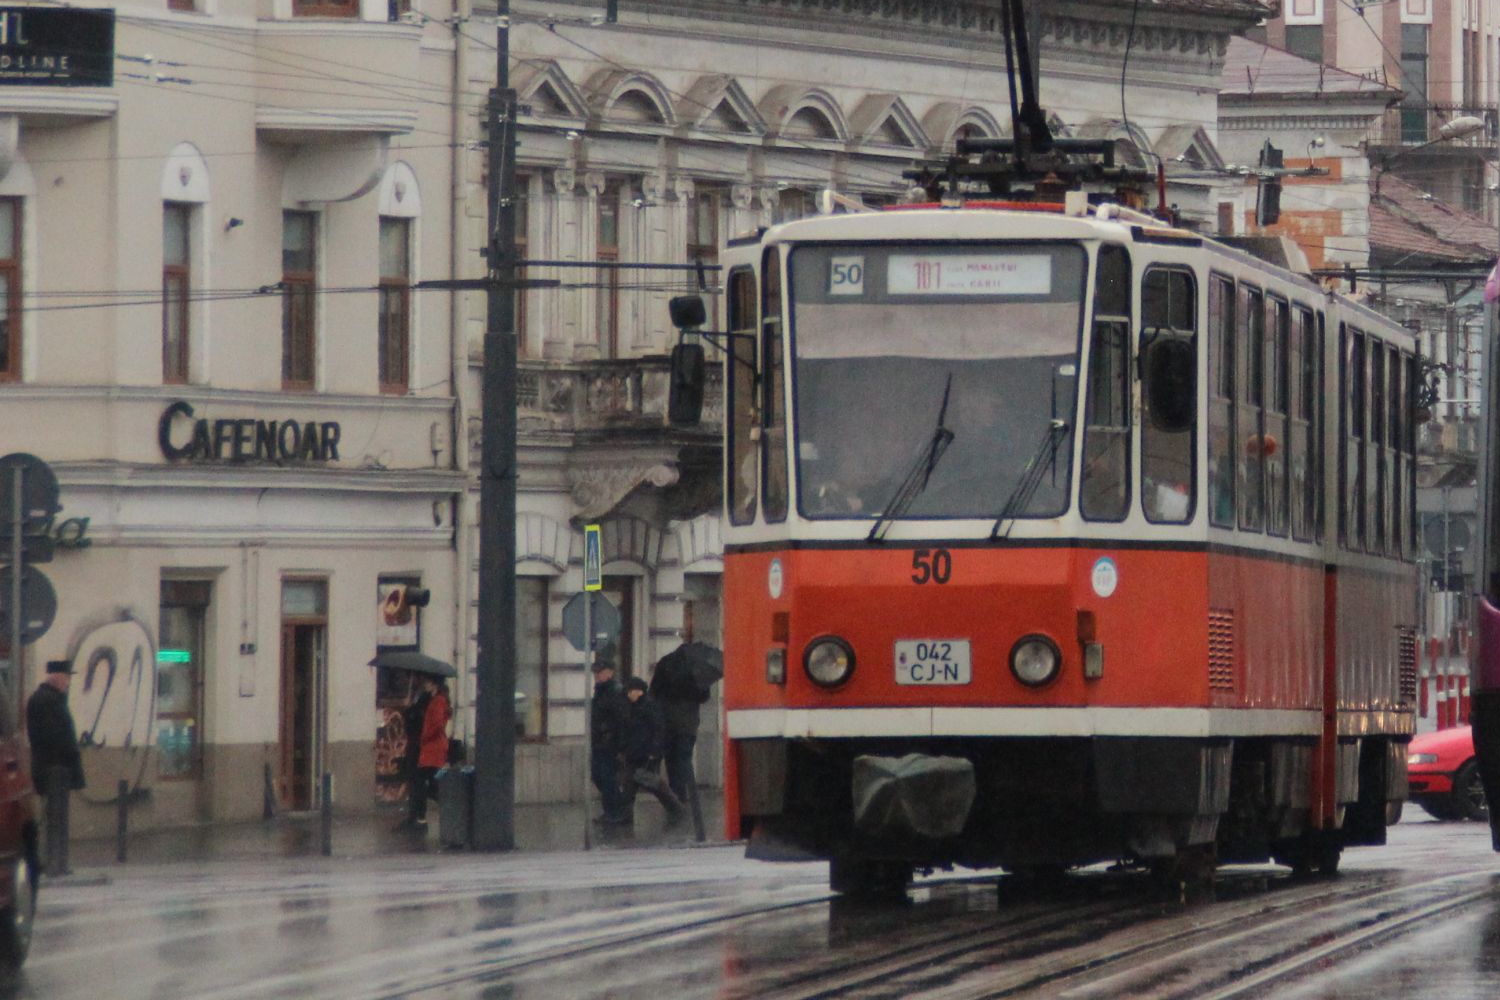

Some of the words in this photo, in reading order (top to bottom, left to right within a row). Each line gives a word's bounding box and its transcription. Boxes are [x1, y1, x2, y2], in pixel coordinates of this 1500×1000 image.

[832, 263, 862, 285] 50
[913, 261, 942, 290] 101
[158, 401, 341, 462] CAFENOAR
[911, 549, 951, 585] 50
[916, 643, 952, 661] 042
[910, 663, 959, 682] CJ-N
